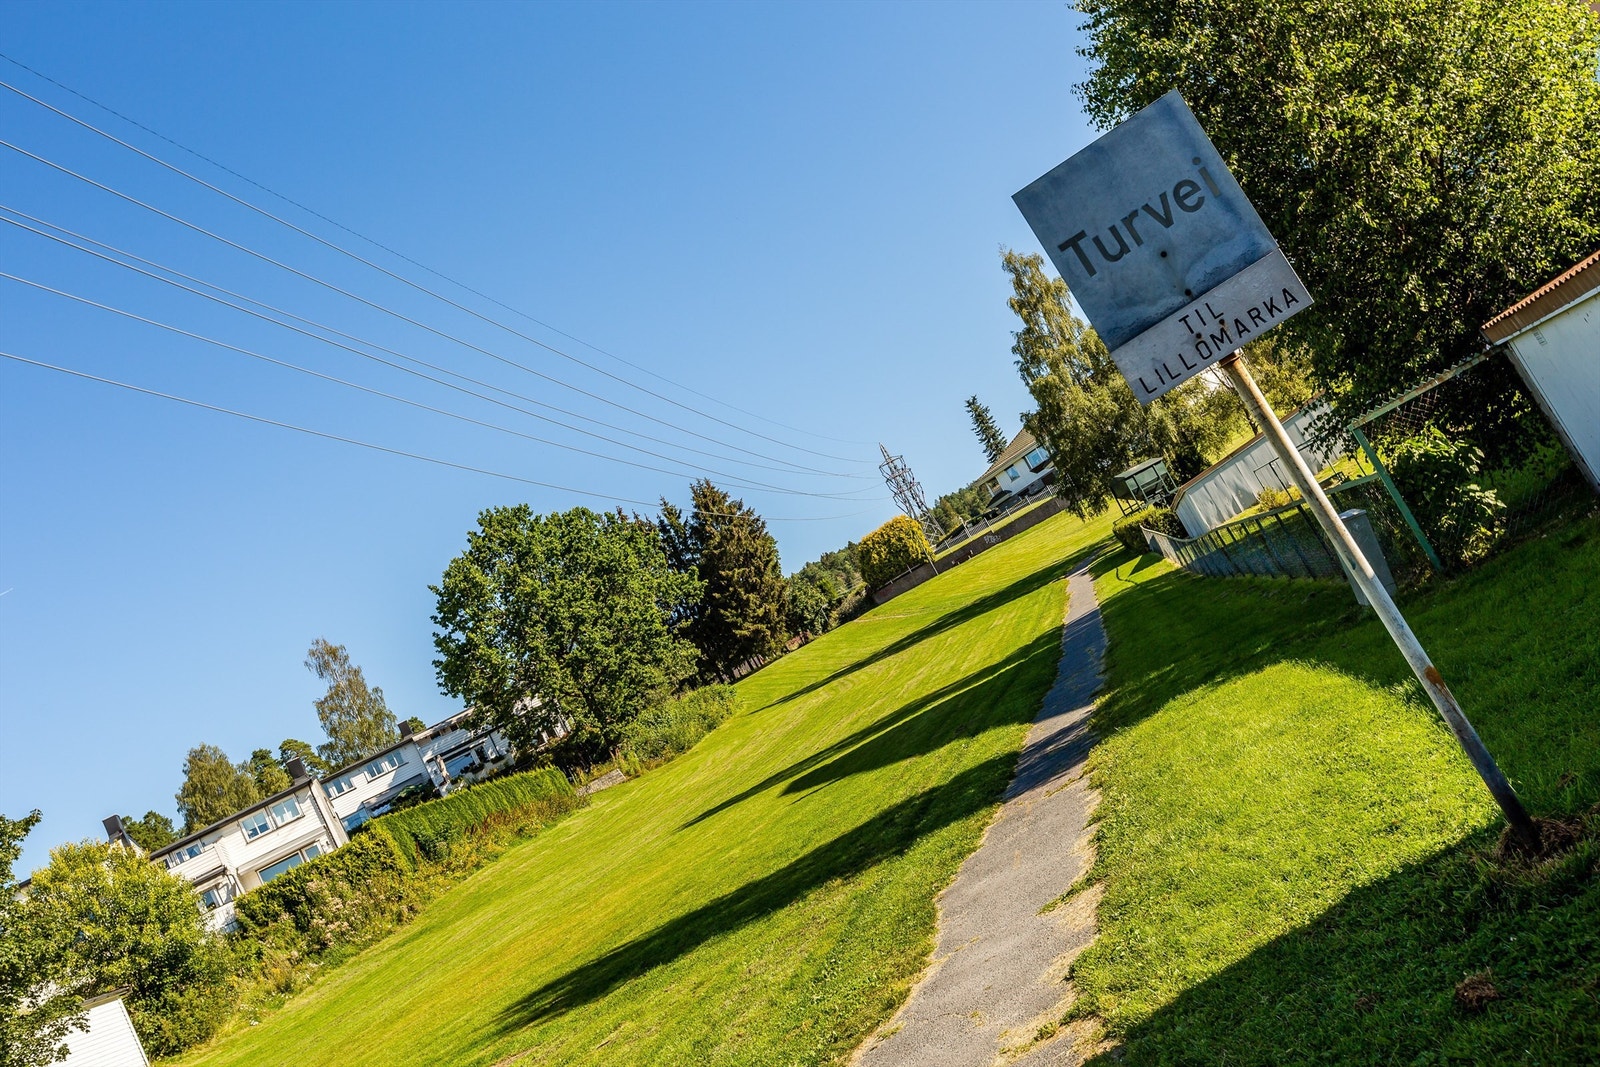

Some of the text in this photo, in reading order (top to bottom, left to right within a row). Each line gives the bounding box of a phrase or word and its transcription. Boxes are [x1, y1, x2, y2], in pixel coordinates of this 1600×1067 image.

[1058, 157, 1221, 277] Turvei
[1139, 287, 1299, 394] LILLOMARKA
[1179, 302, 1224, 334] TIL
